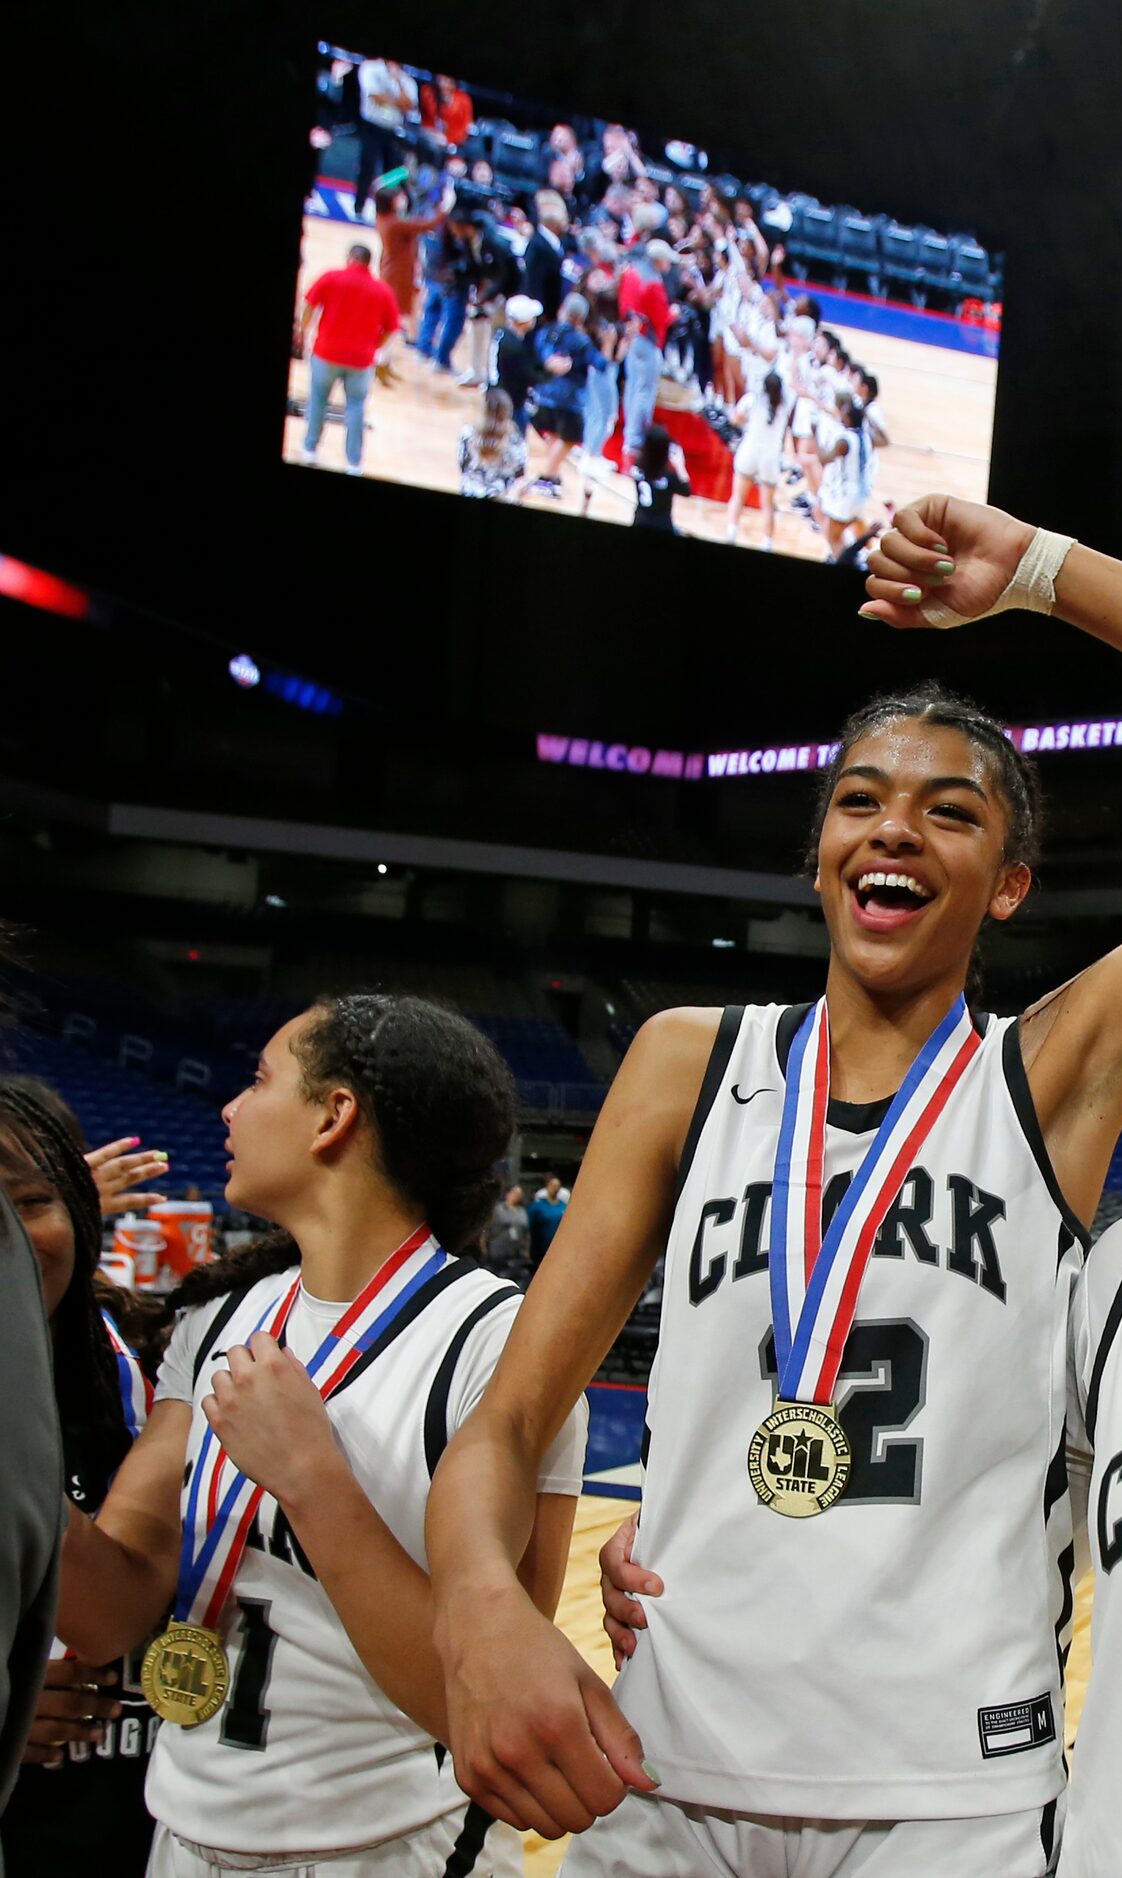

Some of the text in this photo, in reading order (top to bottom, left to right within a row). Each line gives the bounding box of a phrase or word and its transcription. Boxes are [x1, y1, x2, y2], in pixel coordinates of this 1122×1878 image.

[708, 747, 810, 777] WELCOME
[749, 1407, 849, 1508] UNIVERSITY INTERSCHOLASTIC LEAGUE
[766, 1430, 830, 1481] UIL
[776, 1477, 817, 1494] STATE
[984, 1707, 1030, 1721] ENGINEERED
